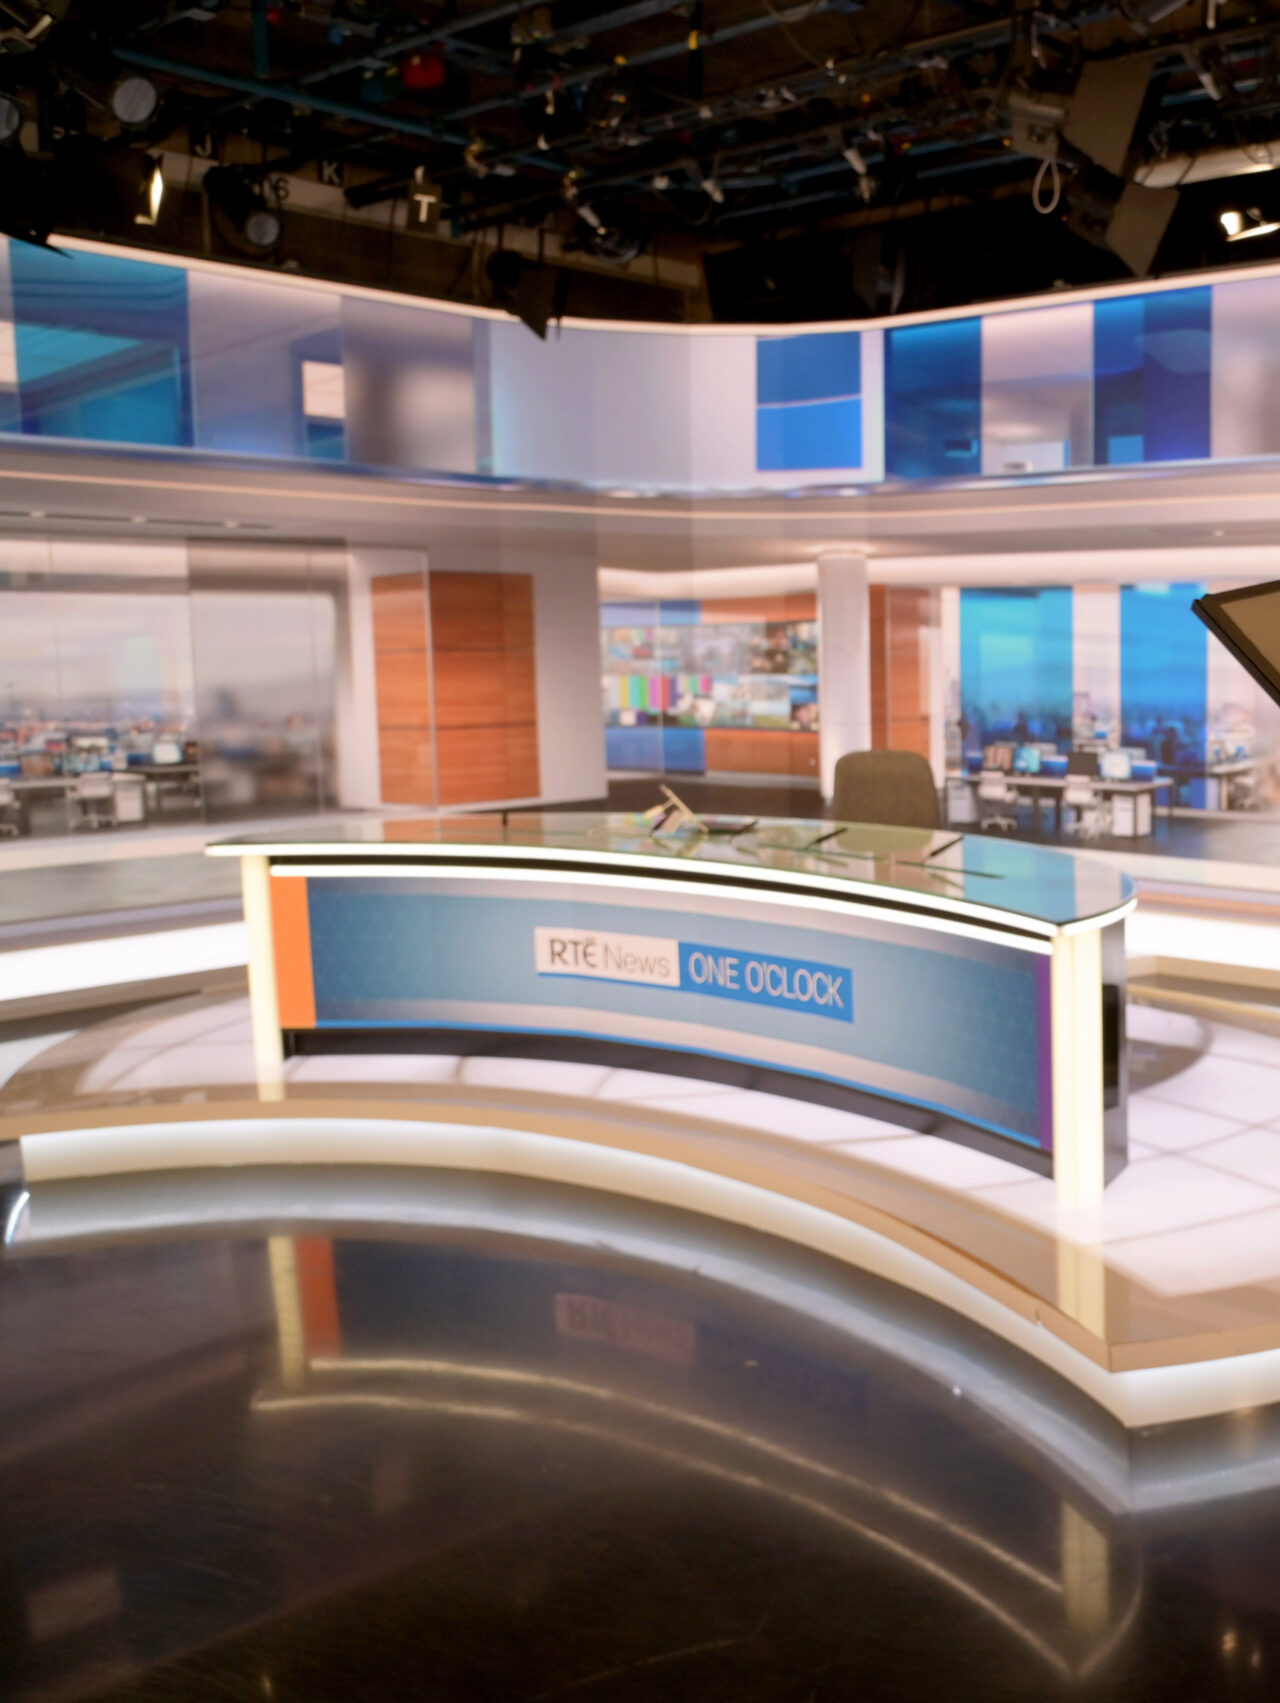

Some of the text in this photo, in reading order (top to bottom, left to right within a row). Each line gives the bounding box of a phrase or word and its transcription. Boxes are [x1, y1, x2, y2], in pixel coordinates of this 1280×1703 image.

[322, 159, 342, 185] K
[413, 194, 438, 223] T
[602, 943, 672, 979] News
[688, 951, 741, 990] ONE
[744, 959, 845, 1008] O'CLOCK
